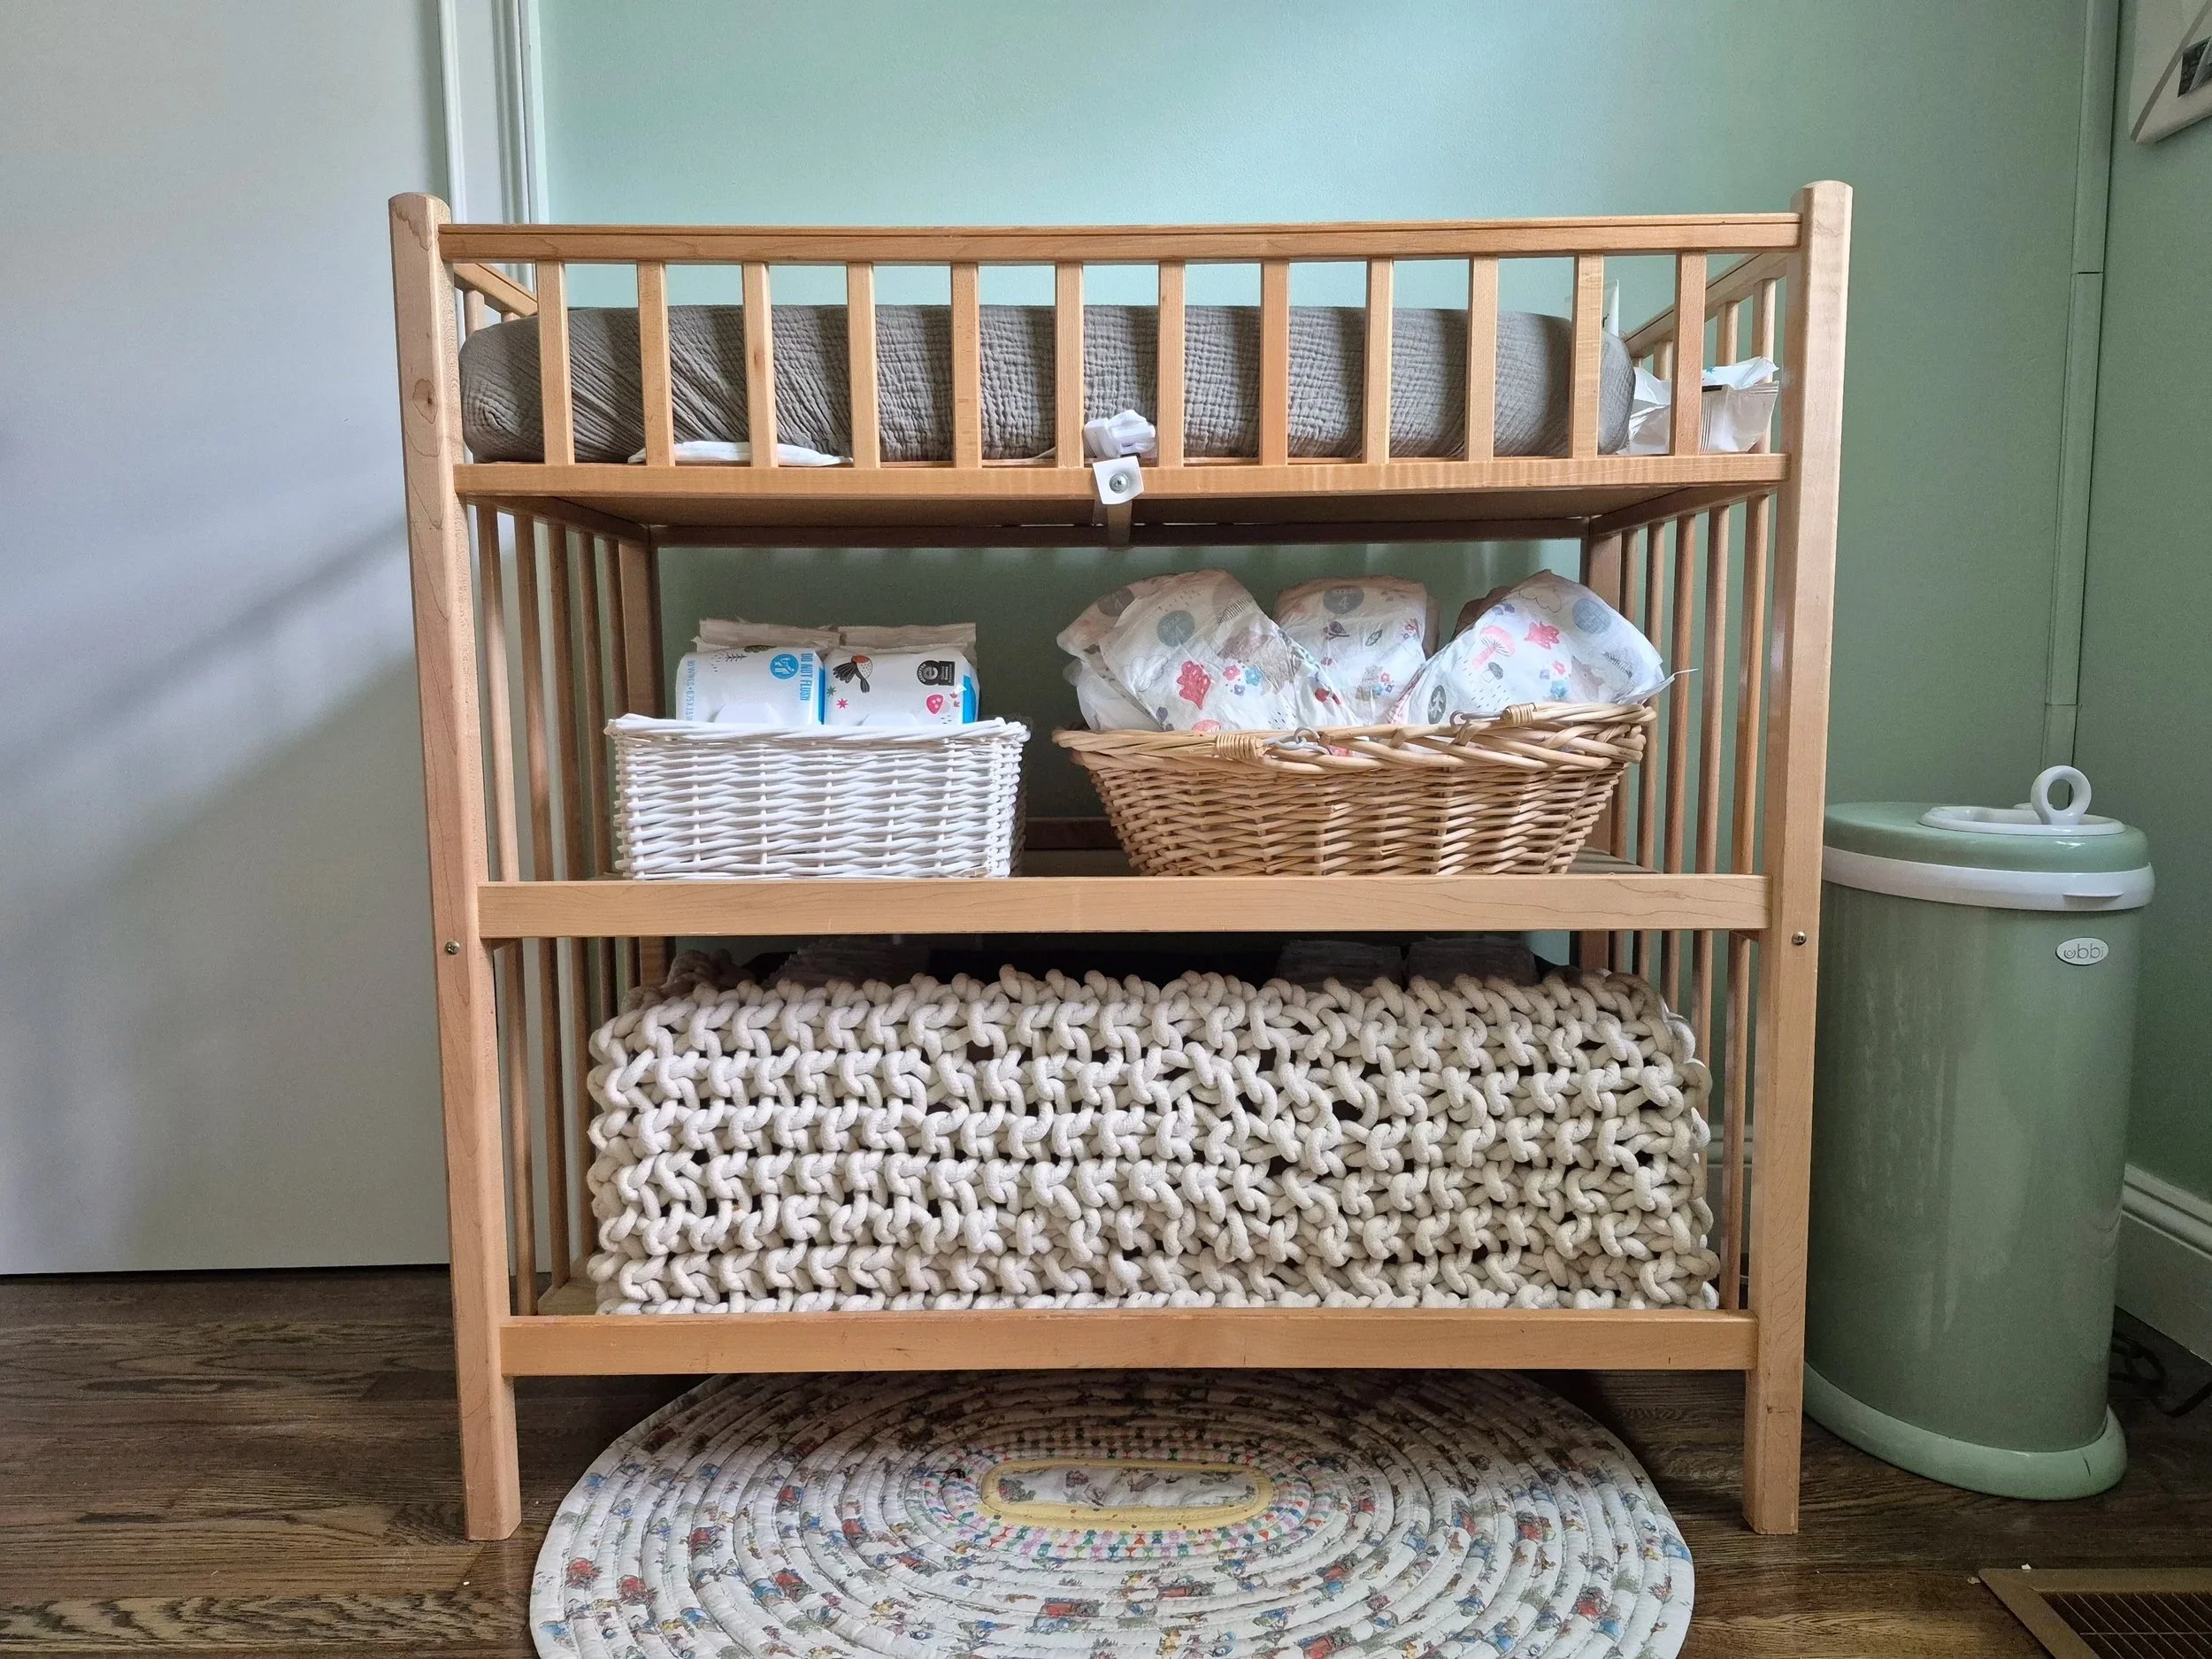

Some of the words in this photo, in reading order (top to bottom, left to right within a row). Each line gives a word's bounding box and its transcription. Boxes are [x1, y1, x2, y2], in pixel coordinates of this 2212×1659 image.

[801, 653, 813, 663] DO
[687, 667, 695, 686] WIPES
[800, 664, 813, 679] NOT
[799, 680, 812, 701] FLUSH
[2063, 942, 2104, 959] ubbi
